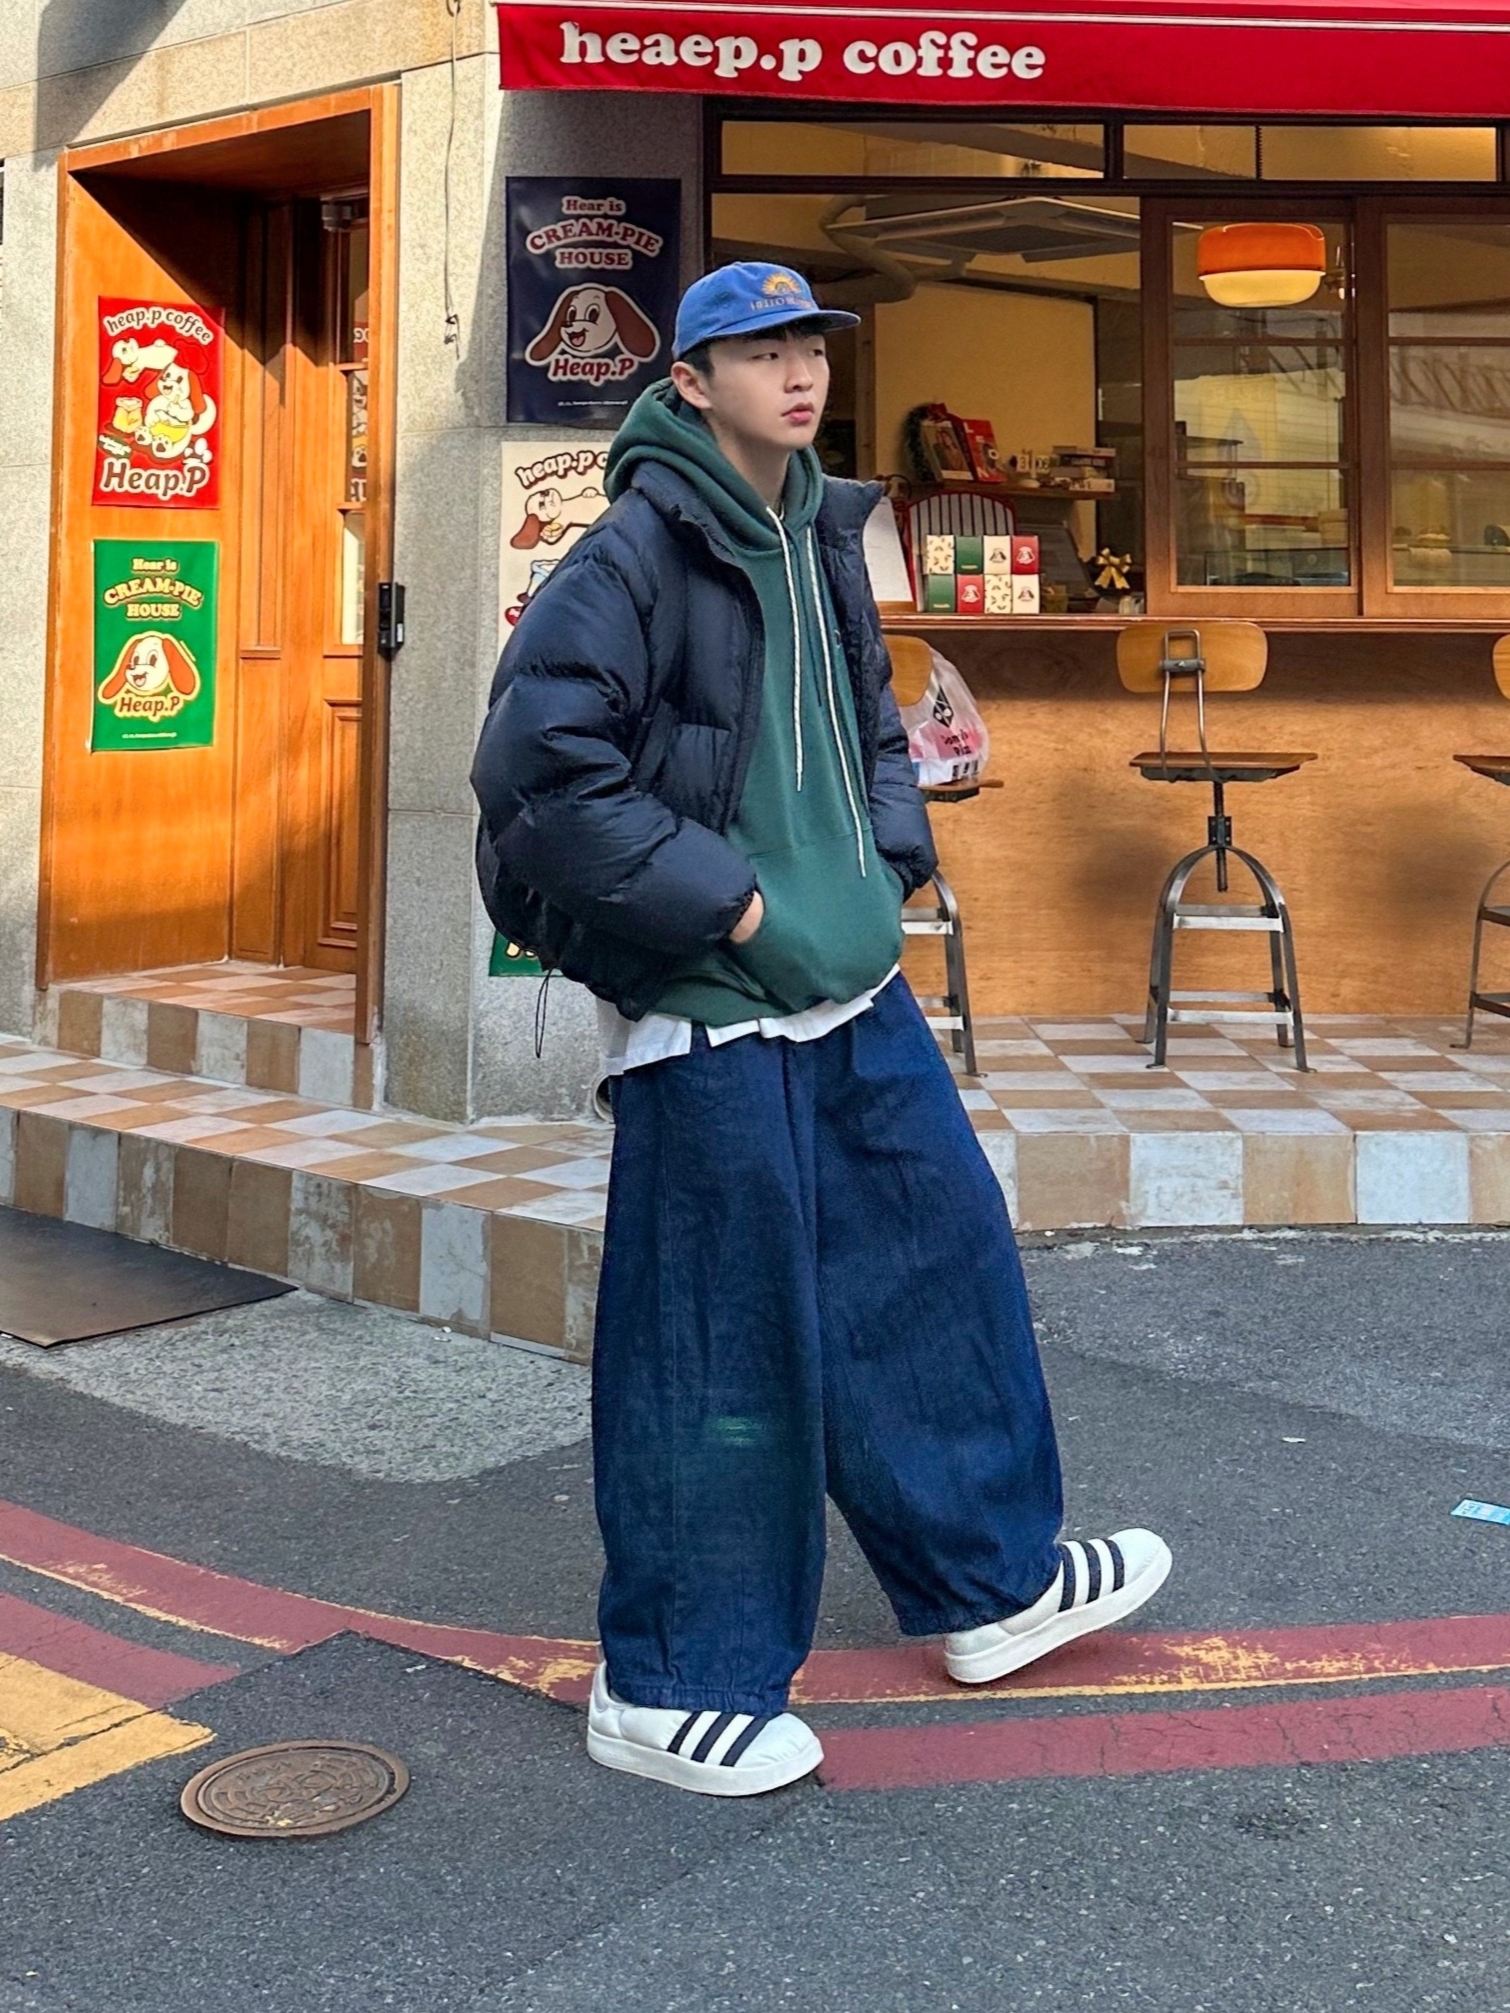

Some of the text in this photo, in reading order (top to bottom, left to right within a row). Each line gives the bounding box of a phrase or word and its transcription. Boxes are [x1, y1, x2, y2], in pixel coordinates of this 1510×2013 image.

[560, 21, 1046, 81] heaep.p coffee
[565, 198, 624, 213] Hear is
[558, 251, 631, 266] HOUSE
[105, 308, 212, 343] heap.p coffee
[552, 357, 636, 382] Heap.P
[102, 460, 208, 498] Heap.P
[515, 450, 596, 489] heap.p
[132, 557, 178, 571] Hear is
[126, 603, 180, 618] HOUSE
[118, 695, 181, 717] Heap.P
